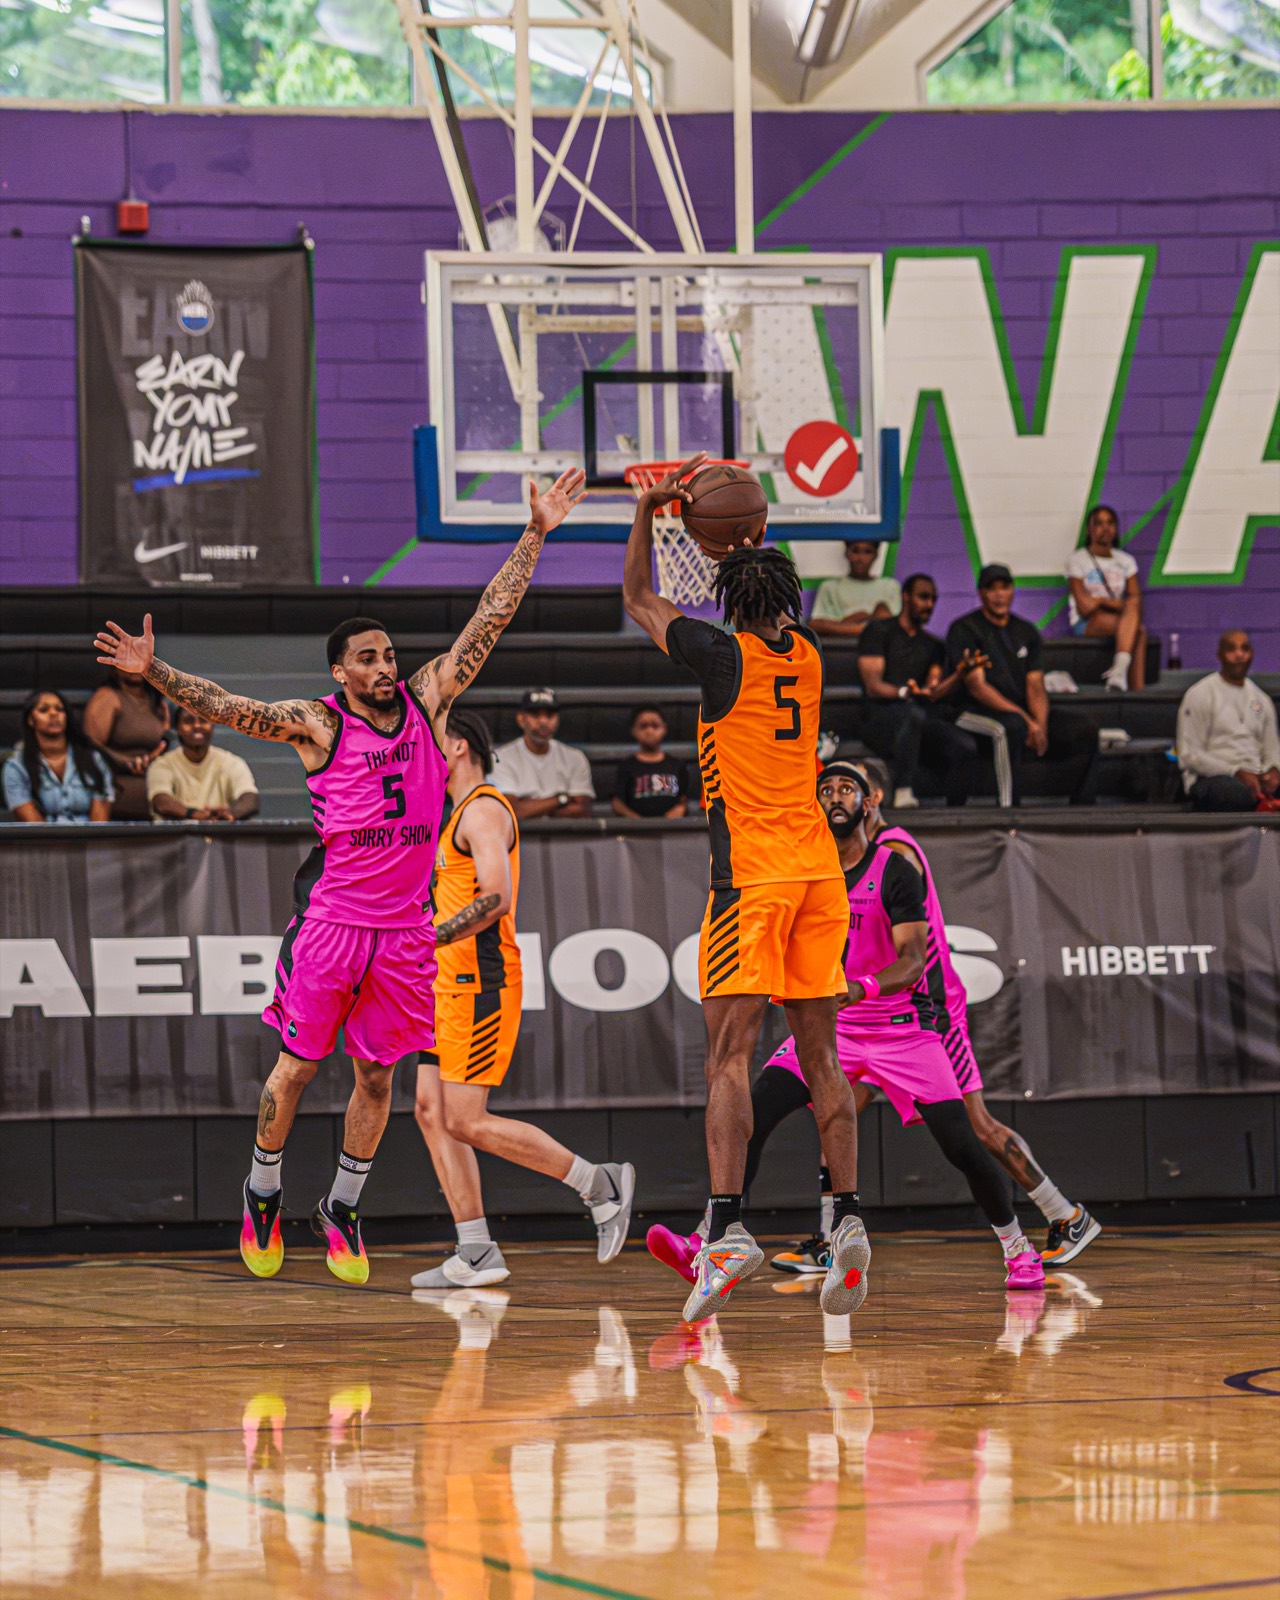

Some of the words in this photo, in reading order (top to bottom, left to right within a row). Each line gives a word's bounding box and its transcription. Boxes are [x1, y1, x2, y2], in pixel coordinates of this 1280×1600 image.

[135, 350, 245, 392] EARN
[146, 391, 239, 432] YOUR
[133, 426, 257, 484] NAME
[774, 676, 801, 740] 5
[362, 747, 389, 771] THE
[392, 742, 418, 764] NOT
[382, 773, 406, 820] 5
[350, 827, 396, 848] SORRY
[400, 823, 433, 847] SHOW
[849, 912, 864, 931] OT
[1061, 945, 1214, 976] HIBBETT
